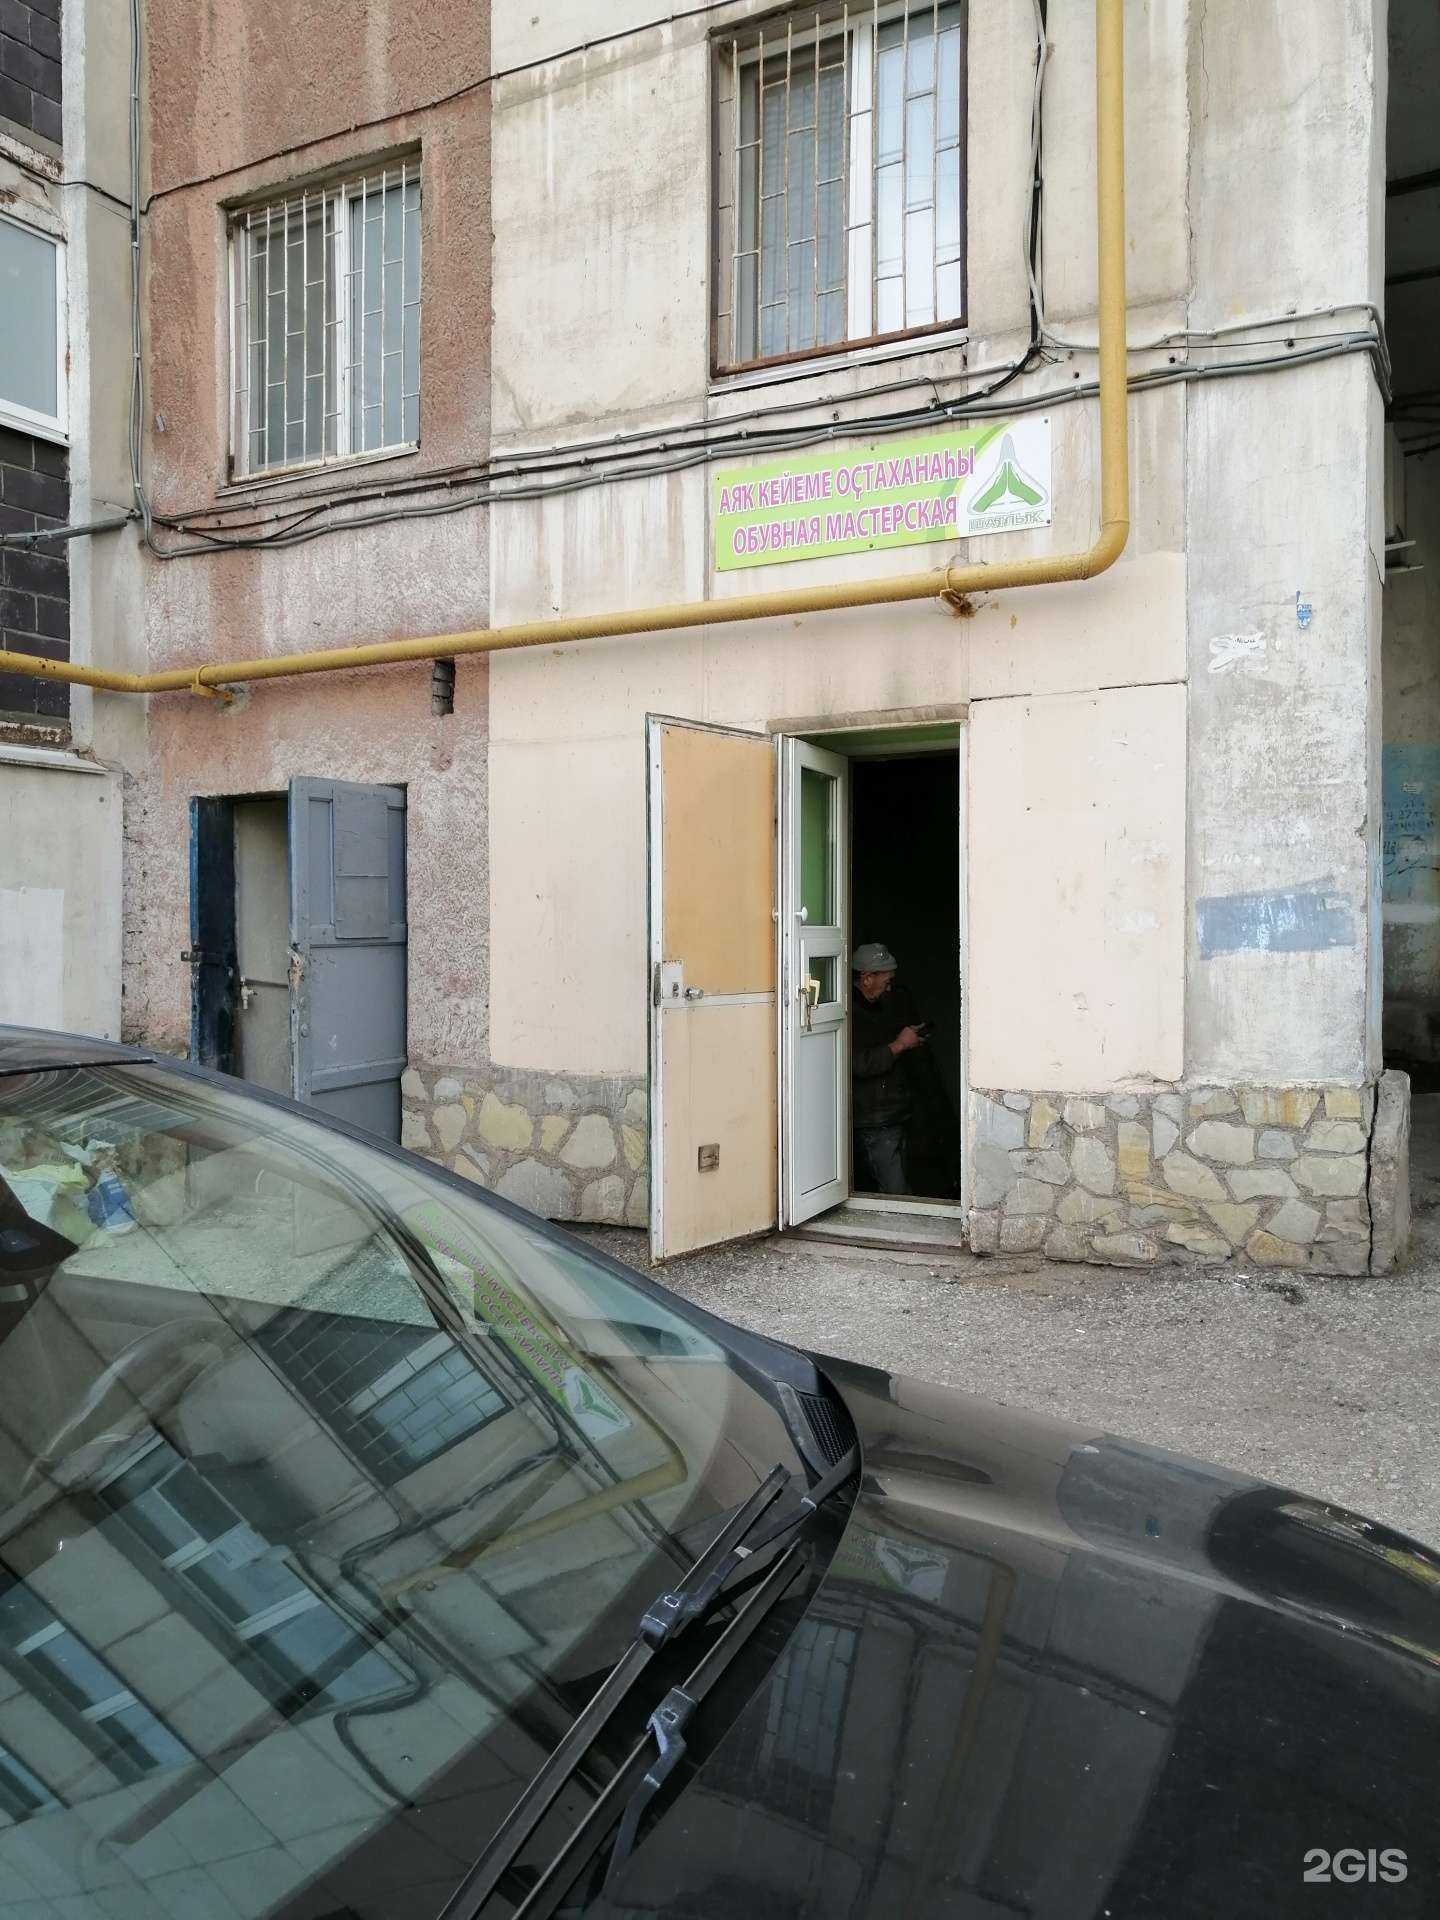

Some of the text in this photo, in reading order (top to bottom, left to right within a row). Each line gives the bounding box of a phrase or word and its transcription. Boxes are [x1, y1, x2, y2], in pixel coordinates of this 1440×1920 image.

[719, 482, 755, 514] АЯК
[758, 471, 832, 508] КЕЙЕМЕ
[733, 496, 957, 554] ОБУВНАЯ МАСТЕРСКАЯ
